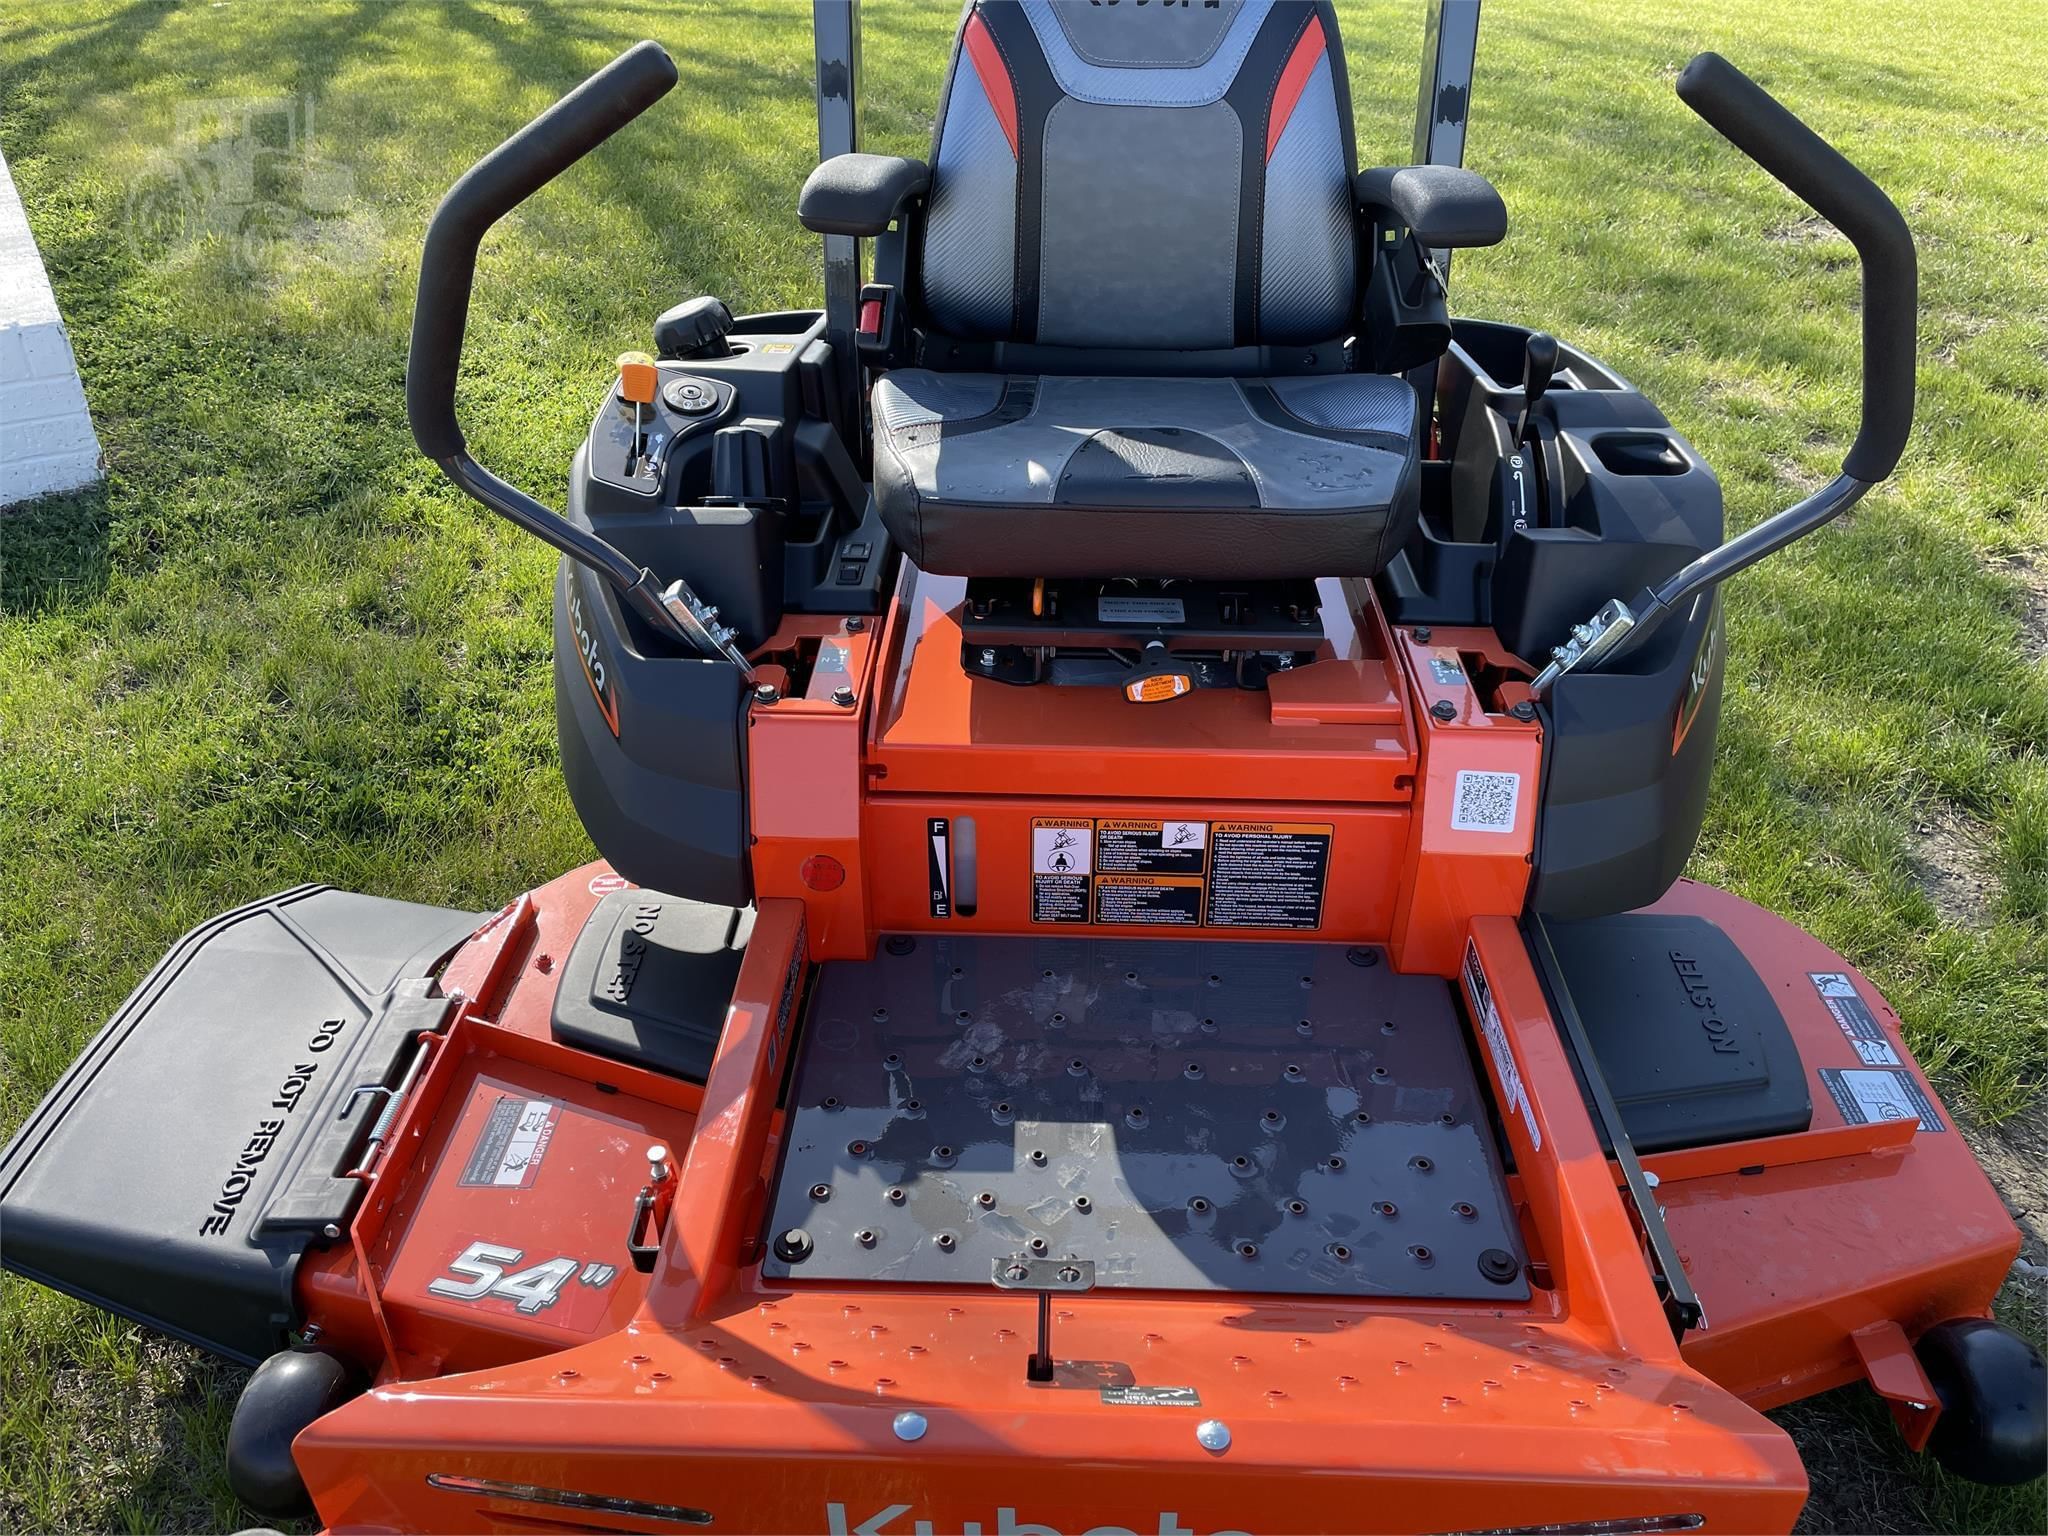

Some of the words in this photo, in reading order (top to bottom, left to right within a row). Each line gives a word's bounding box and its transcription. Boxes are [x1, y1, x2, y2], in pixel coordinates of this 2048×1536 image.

[934, 822, 944, 832] F
[1227, 824, 1273, 832] WARNING
[631, 904, 662, 935] NO
[936, 904, 946, 914] E
[607, 940, 647, 1002] STEP
[1826, 999, 1851, 1033] DANGER
[308, 1018, 346, 1052] DO
[272, 1062, 318, 1113] NOT
[530, 1129, 552, 1165] DANGER
[199, 1119, 285, 1236] REMOVE
[428, 1240, 616, 1313] 54"
